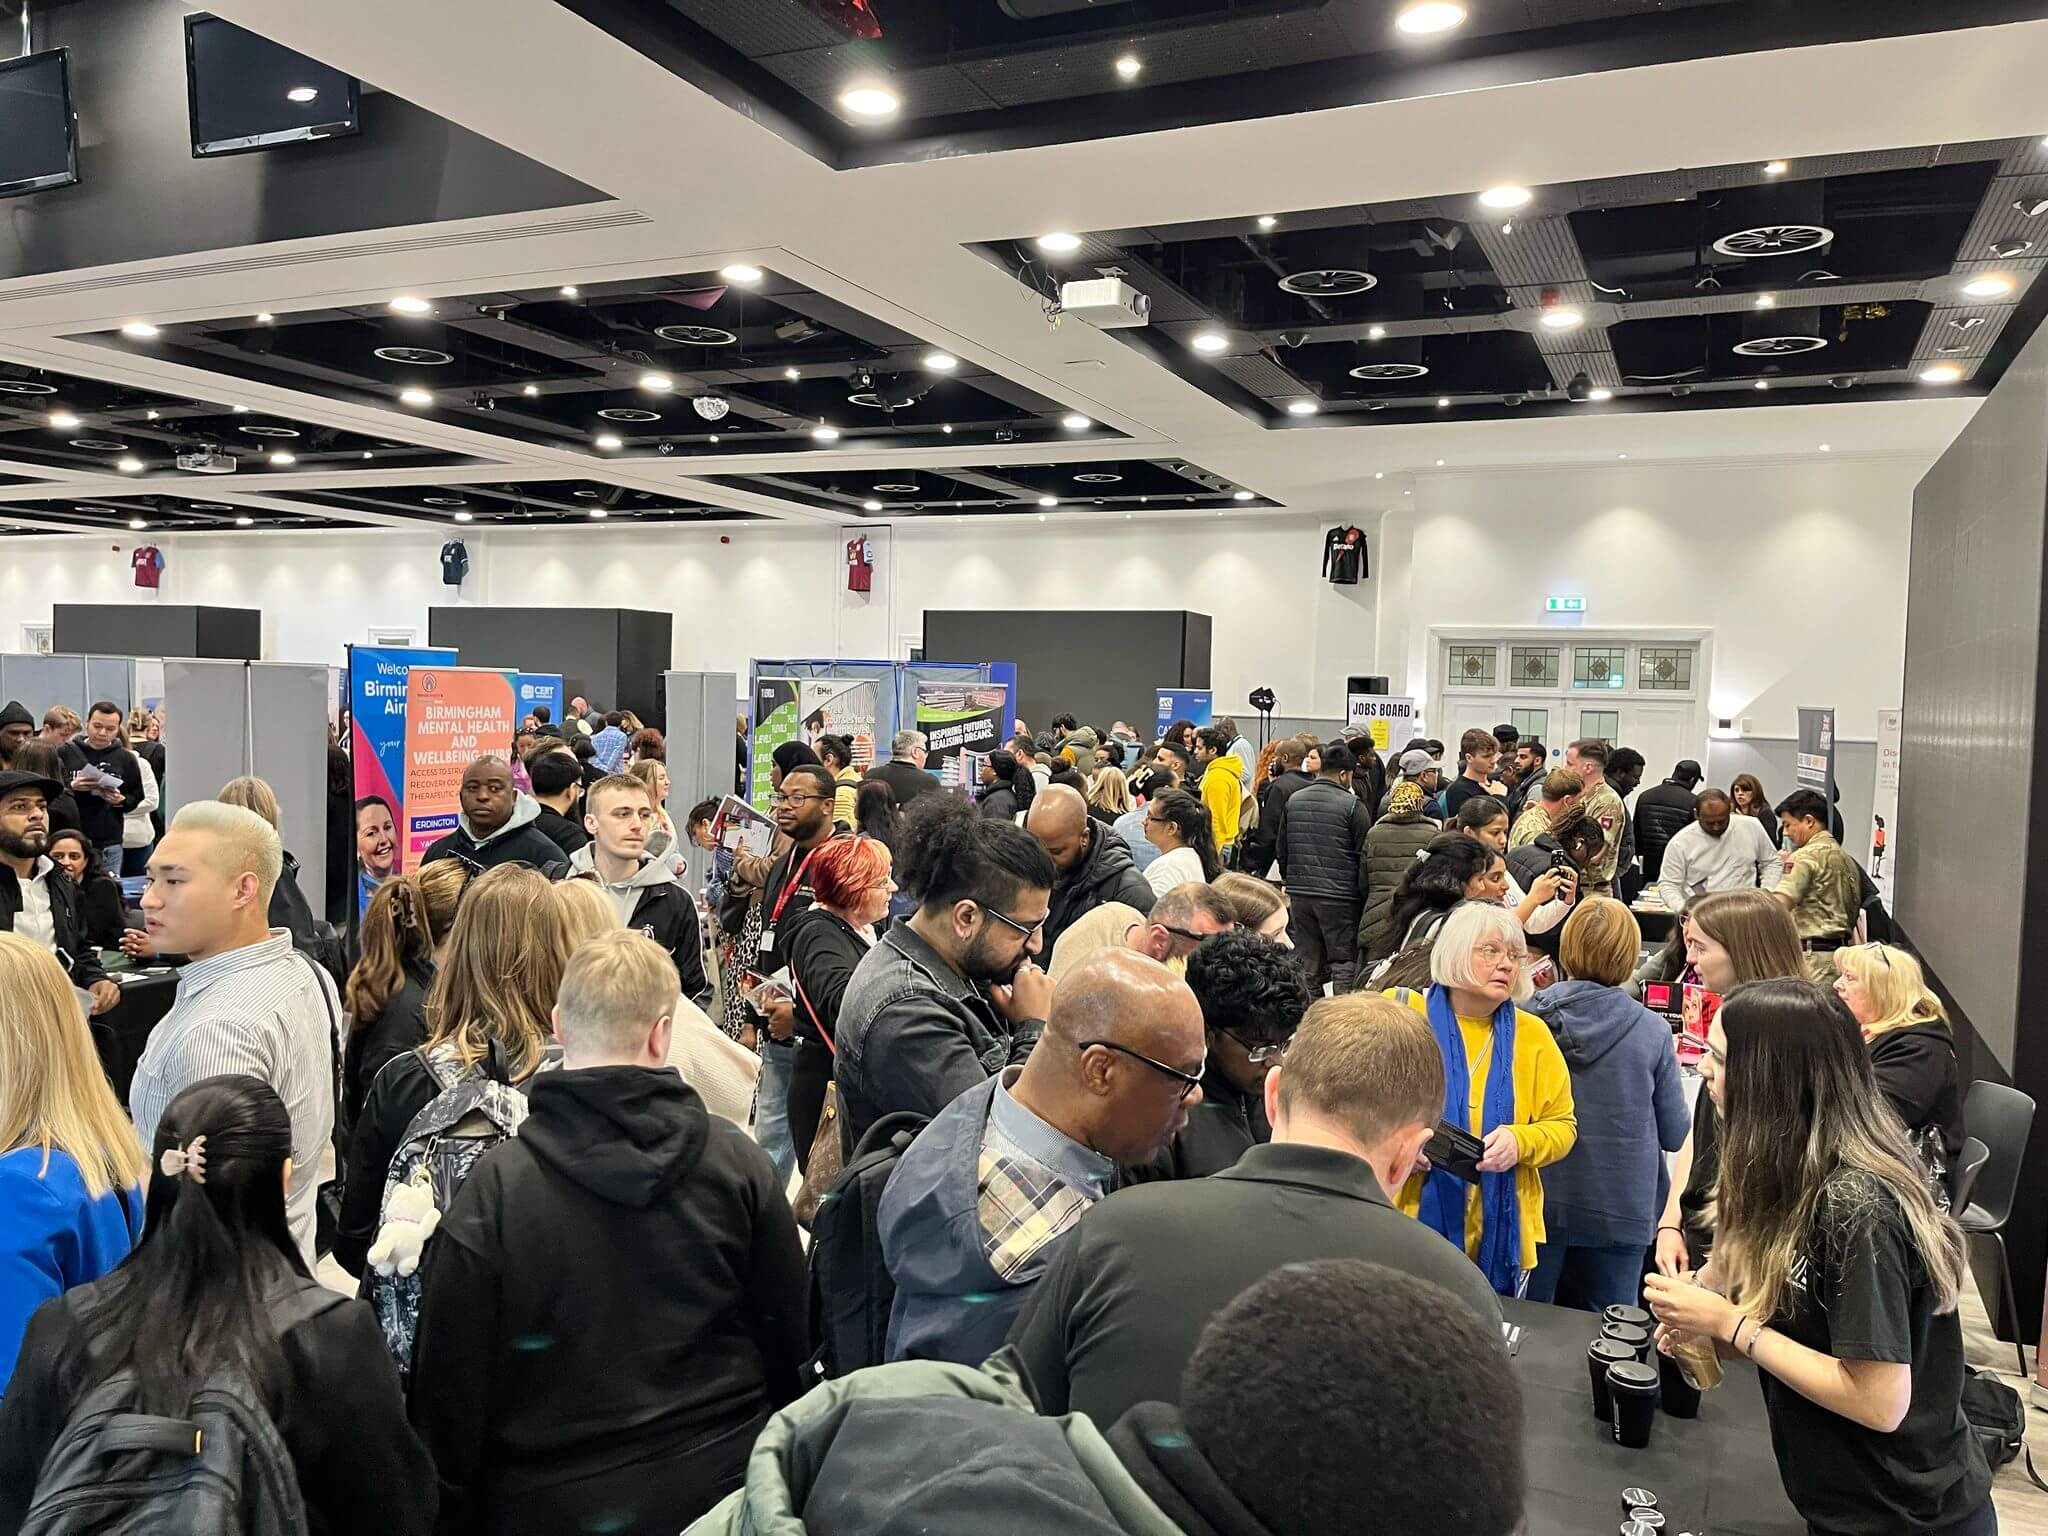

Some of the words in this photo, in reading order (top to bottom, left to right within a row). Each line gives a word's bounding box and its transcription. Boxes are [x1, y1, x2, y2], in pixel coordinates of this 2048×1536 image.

[377, 663, 408, 675] Welco
[364, 680, 408, 697] Birmin
[384, 699, 408, 717] Air
[425, 705, 501, 720] BIRMINGHAM
[1353, 702, 1377, 716] JOBS
[1379, 703, 1410, 718] BOARD
[417, 721, 464, 735] MENTAL
[467, 720, 510, 734] HEALTH
[929, 724, 962, 741] INSPIRING
[963, 718, 994, 734] FUTURES,
[451, 735, 477, 749] AND
[930, 735, 964, 752] REALISING
[964, 728, 994, 743] DREAMS.
[413, 749, 480, 765] WELLBEING
[410, 768, 437, 777] ACCESS
[447, 767, 463, 775] STRU
[410, 781, 445, 789] RECOVERY
[415, 817, 456, 829] ERDINGTON
